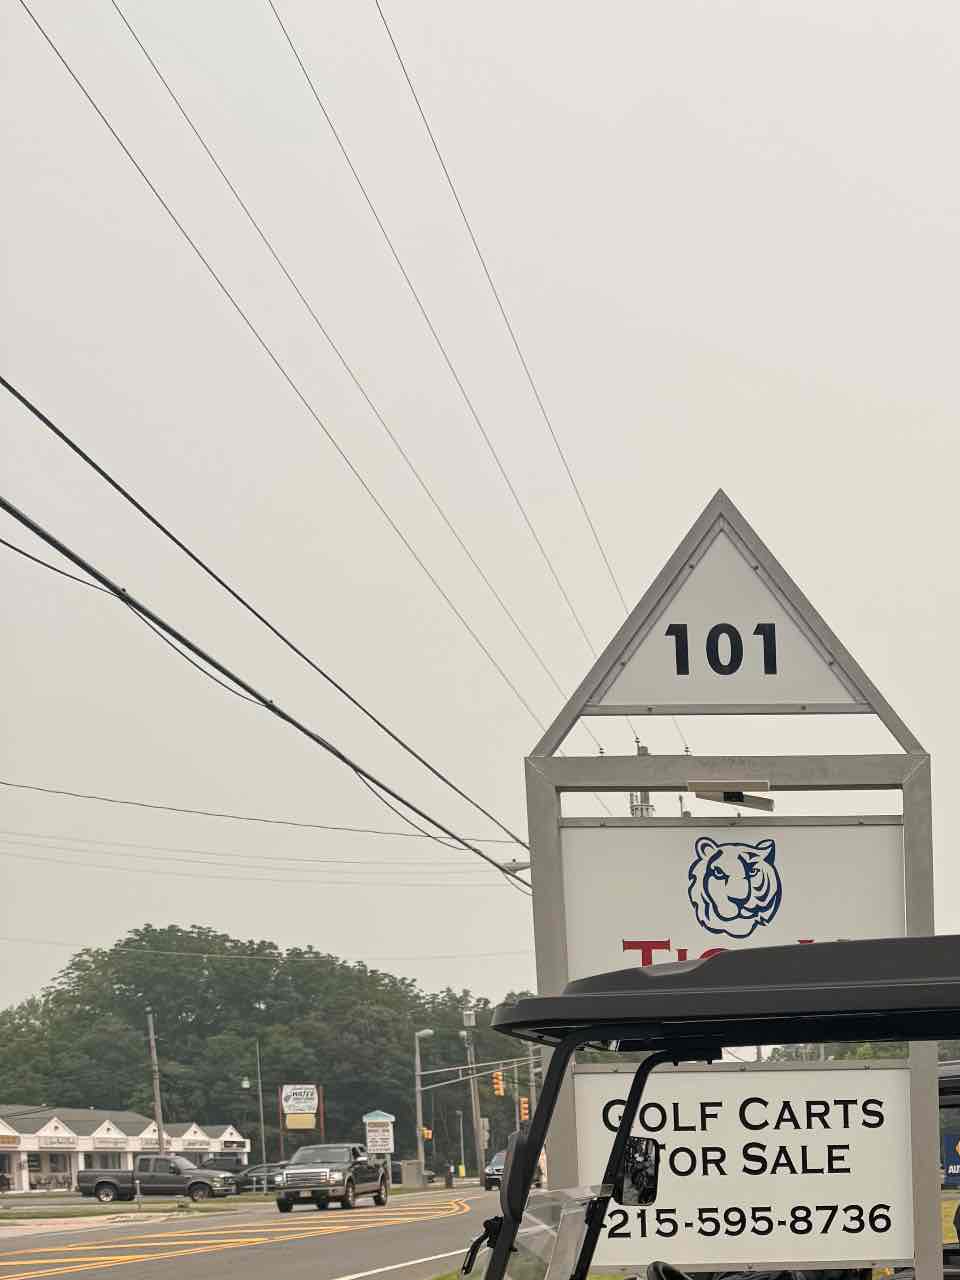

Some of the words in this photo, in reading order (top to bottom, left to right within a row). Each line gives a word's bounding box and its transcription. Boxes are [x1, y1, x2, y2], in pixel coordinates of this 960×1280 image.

[664, 622, 778, 676] 101
[602, 1098, 723, 1133] GOLF
[738, 1097, 885, 1131] CARTS
[742, 1141, 851, 1175] SALE
[607, 1203, 892, 1239] 215-595-8736
